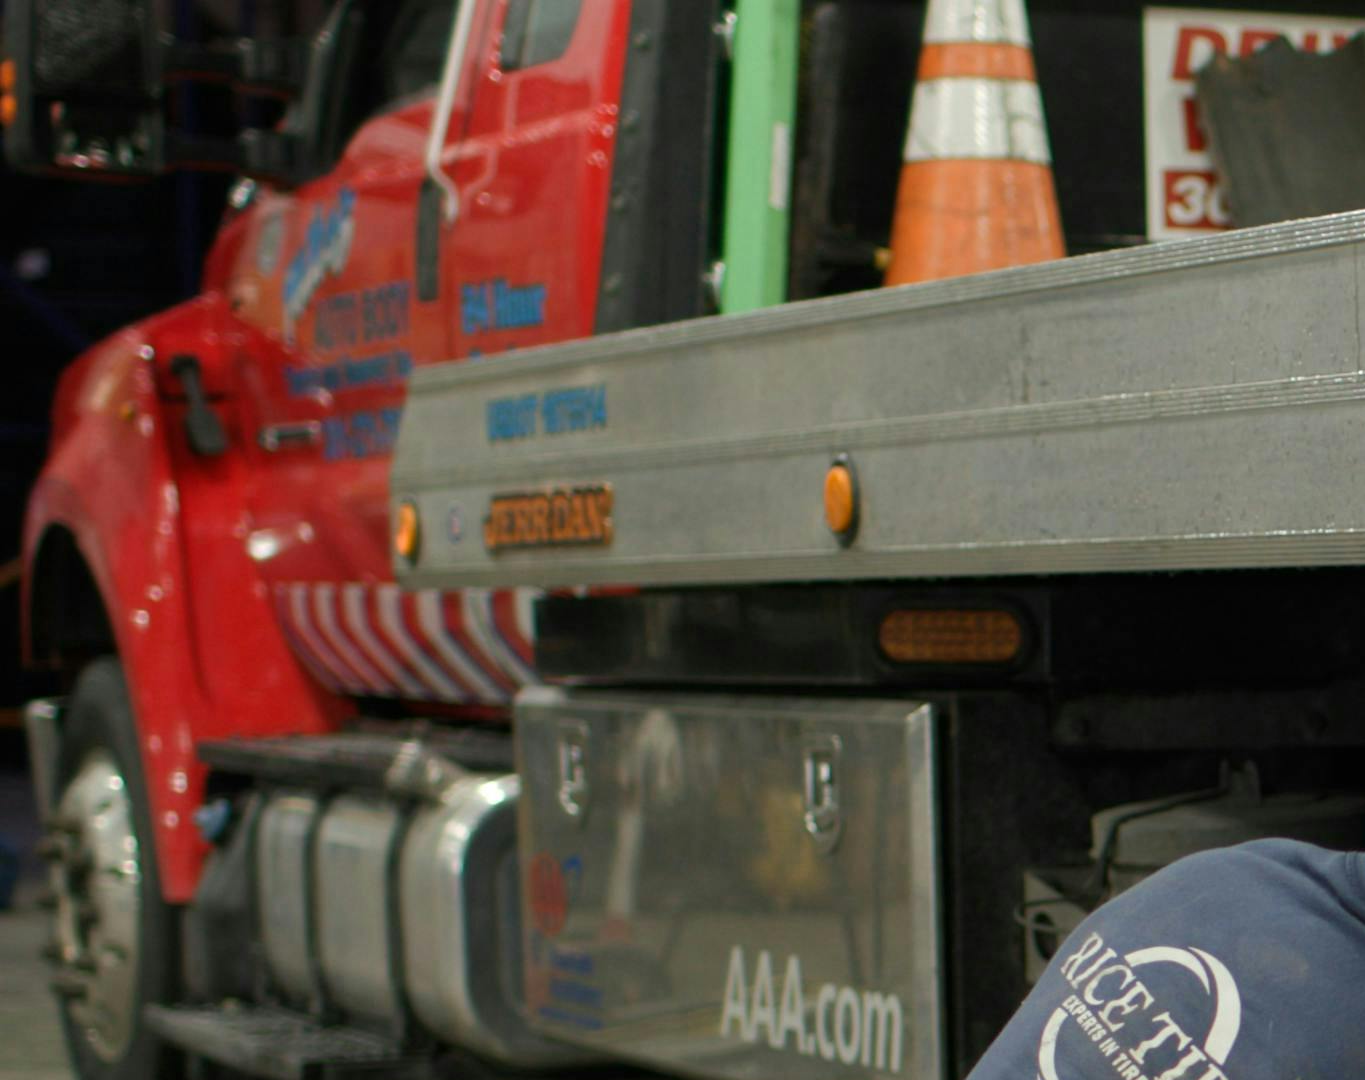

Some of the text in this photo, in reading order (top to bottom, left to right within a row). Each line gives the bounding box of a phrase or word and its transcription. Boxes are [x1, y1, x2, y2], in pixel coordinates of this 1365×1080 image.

[721, 945, 902, 1073] AAA.com
[1060, 932, 1155, 1033] RICE
[1062, 994, 1104, 1042] EXPERTS
[1098, 1036, 1119, 1058] IN
